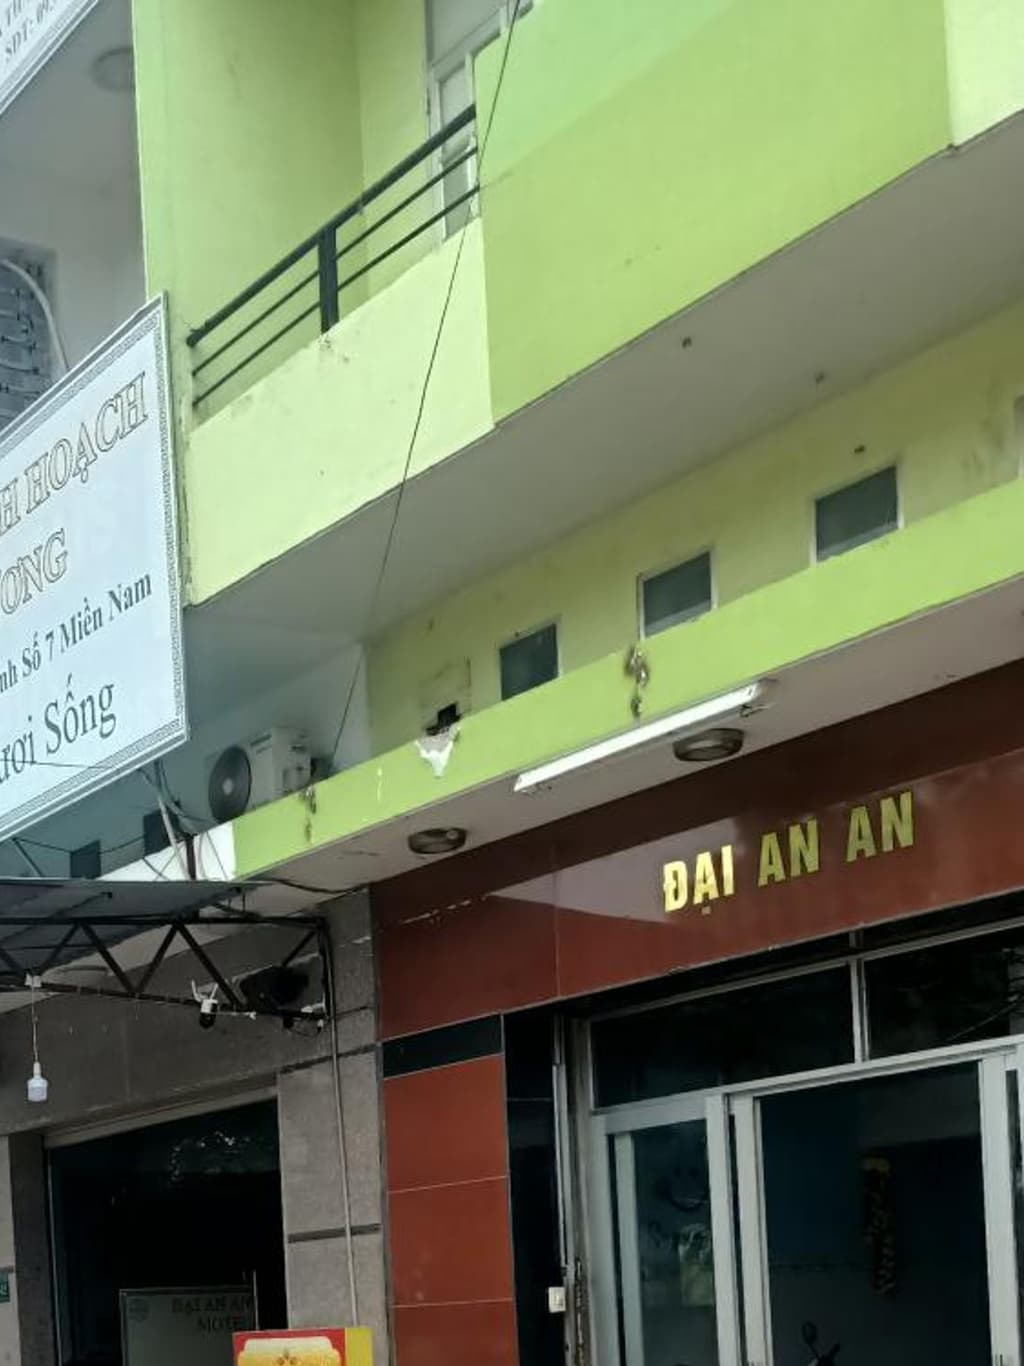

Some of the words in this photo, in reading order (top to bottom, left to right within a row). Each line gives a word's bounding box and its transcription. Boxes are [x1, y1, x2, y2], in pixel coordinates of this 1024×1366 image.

[23, 371, 149, 515] HOẠCH
[21, 630, 42, 678] Số
[44, 630, 55, 662] 7
[58, 596, 103, 654] Miền
[106, 573, 152, 623] Nam
[42, 671, 118, 756] Sống
[661, 843, 735, 916] ĐẠI
[757, 815, 821, 888] AN
[845, 790, 916, 864] AN
